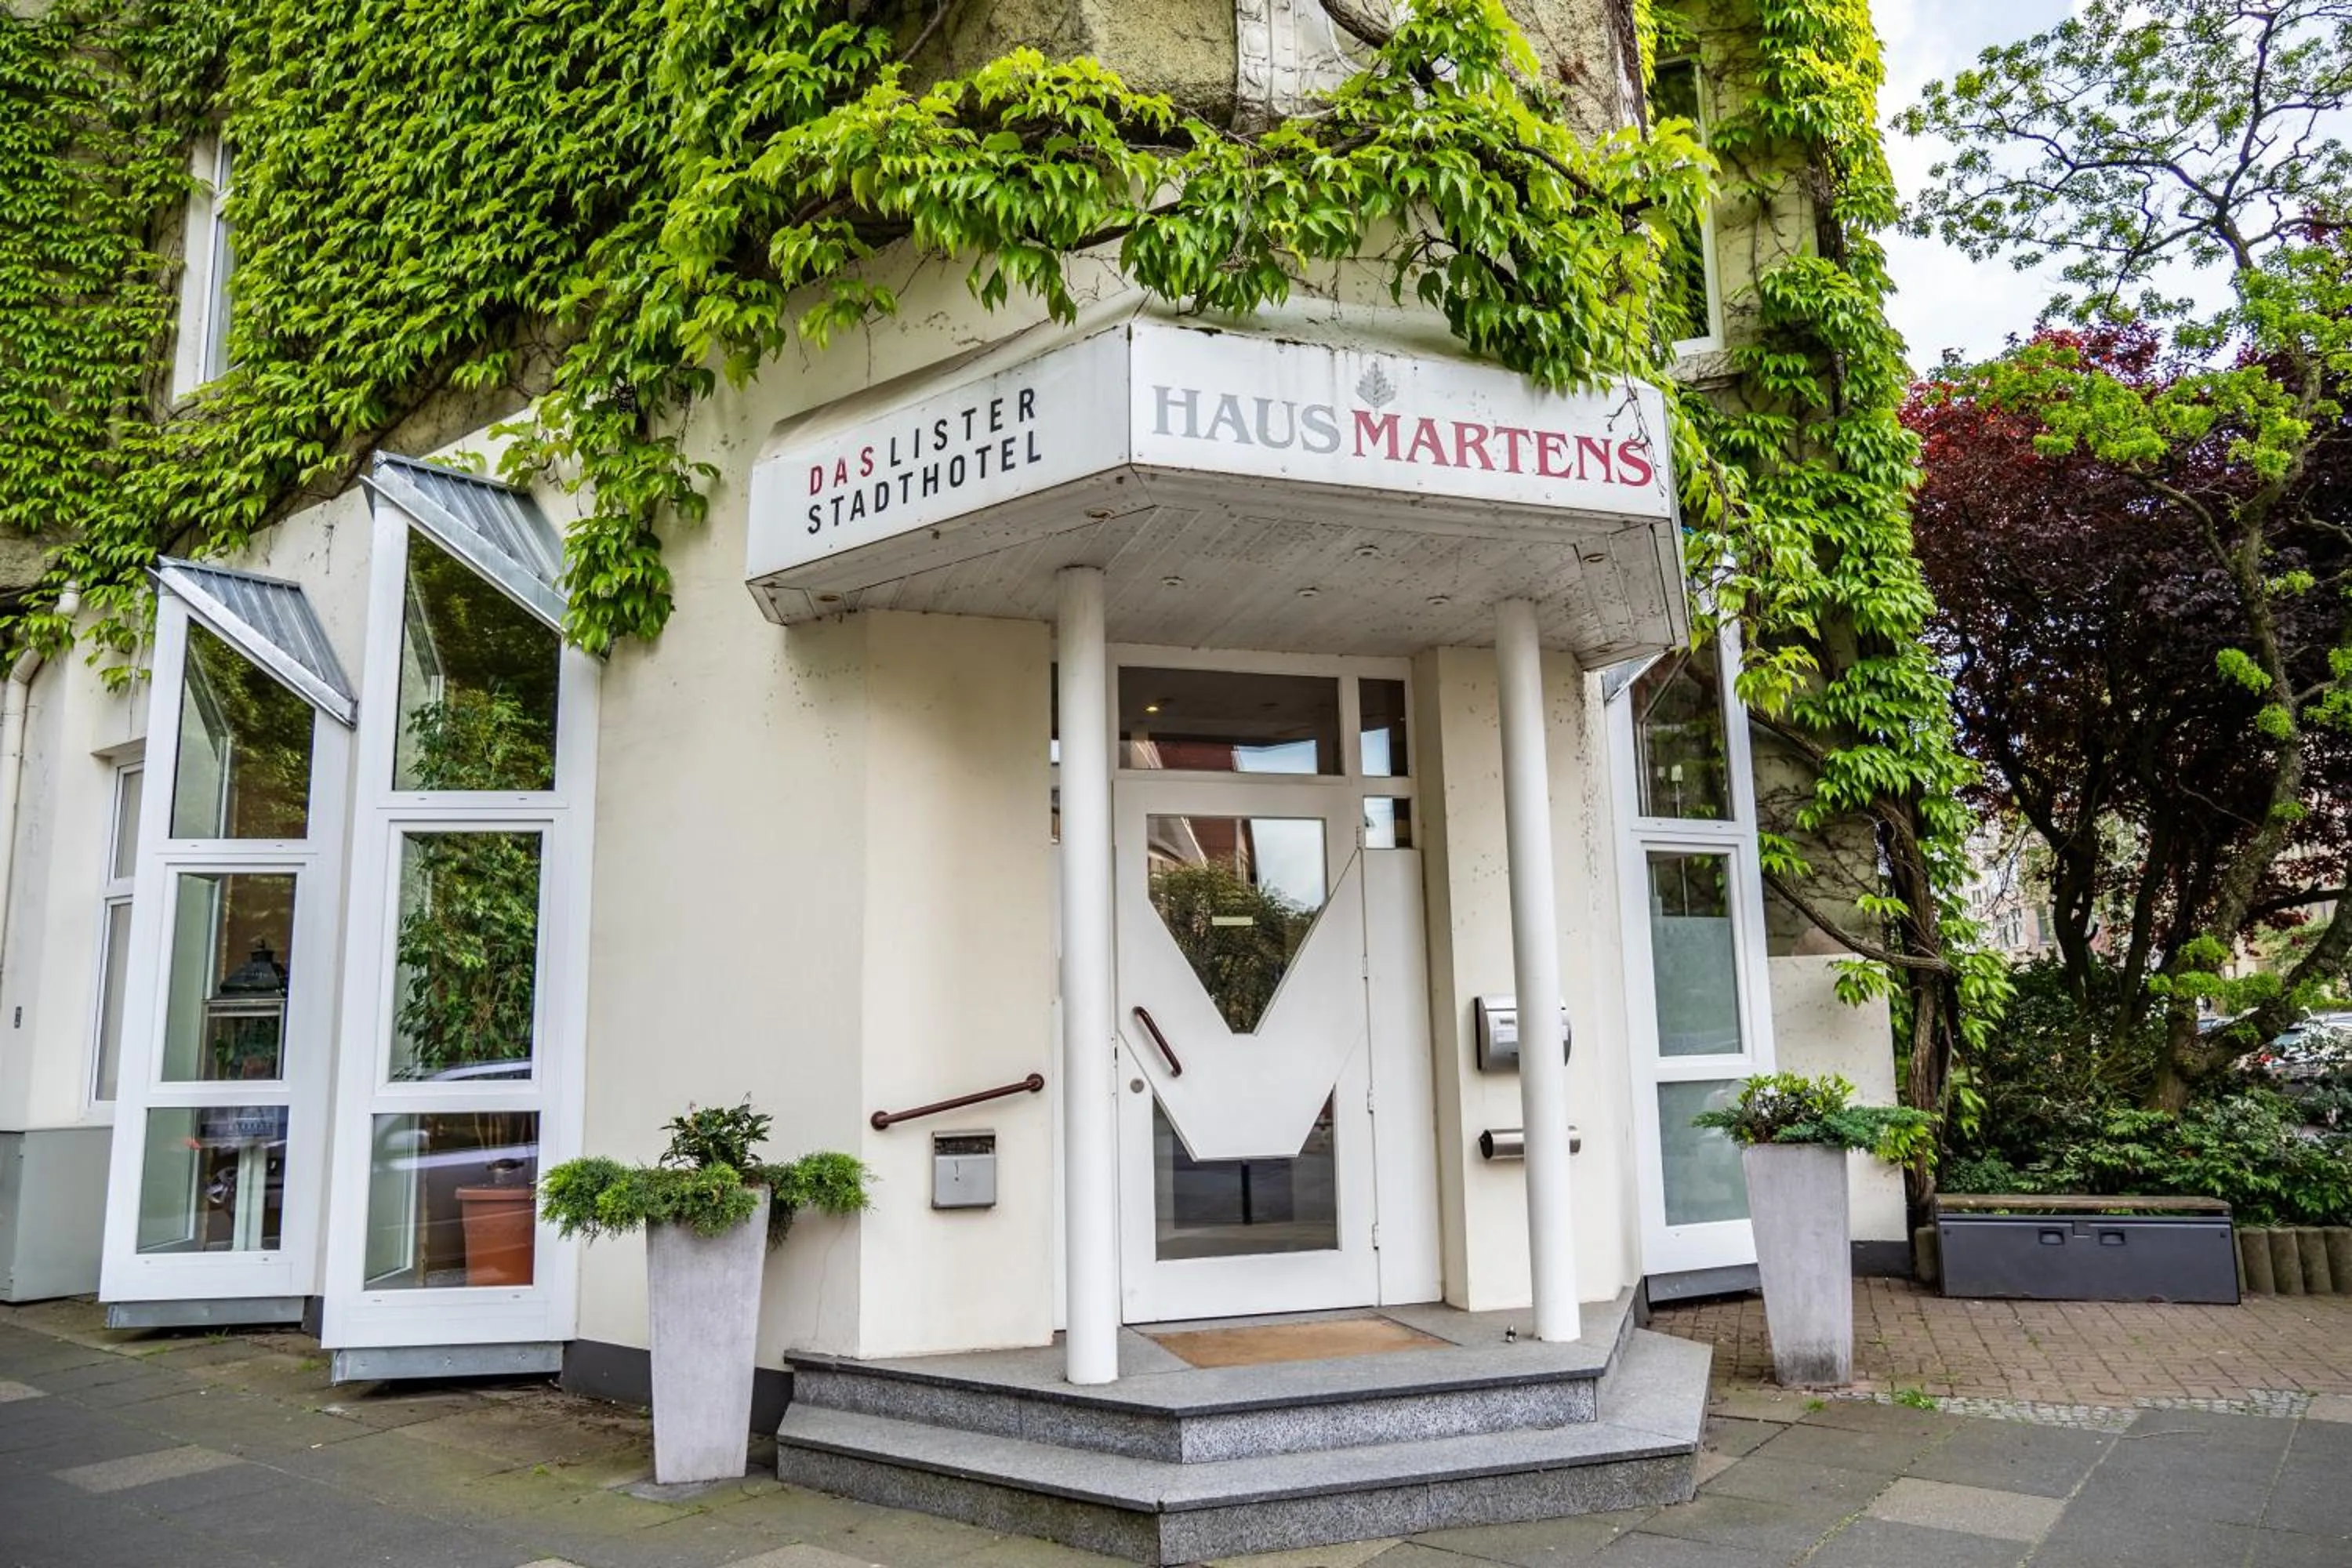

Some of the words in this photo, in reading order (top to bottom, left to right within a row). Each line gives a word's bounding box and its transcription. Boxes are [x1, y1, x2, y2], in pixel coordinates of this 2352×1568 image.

[808, 430, 1042, 535] STADTHOTEL
[1152, 385, 1341, 453] HAUS
[1352, 409, 1653, 487] MARTENS
